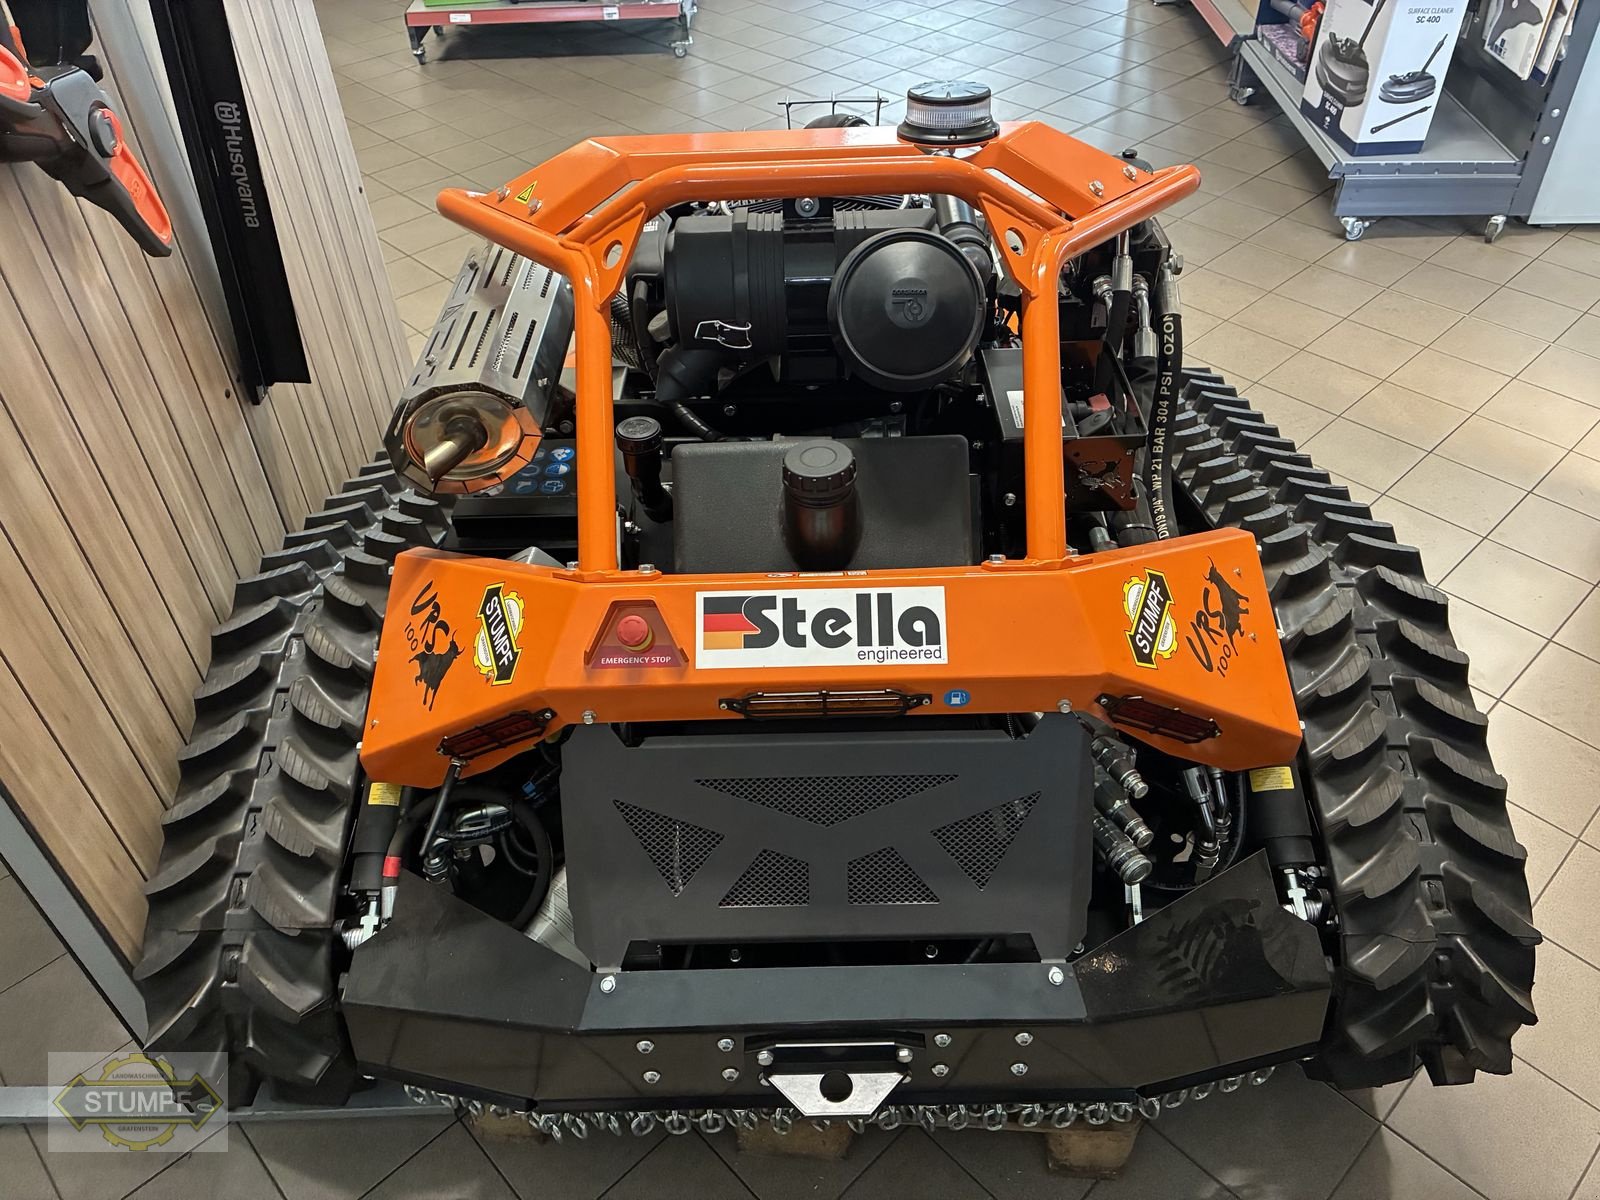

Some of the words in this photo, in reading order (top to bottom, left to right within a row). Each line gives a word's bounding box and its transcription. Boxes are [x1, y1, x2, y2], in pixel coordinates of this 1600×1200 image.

[1407, 7, 1431, 15] SURFACE
[1415, 15, 1426, 24] SC
[1426, 15, 1441, 24] 400
[222, 125, 260, 228] Husqvarna
[1160, 371, 1173, 395] PSI
[1156, 400, 1169, 423] 304
[1152, 427, 1167, 453] BAR
[1151, 458, 1163, 471] 21
[1151, 474, 1163, 492] WP
[742, 592, 941, 650] Stella
[1135, 580, 1164, 655] STUMPF
[404, 621, 419, 652] 100
[485, 596, 514, 667] STUMPF
[601, 656, 649, 665] EMERGENCY
[650, 655, 672, 664] STOP
[857, 645, 942, 663] engineered
[1217, 643, 1232, 678] 100
